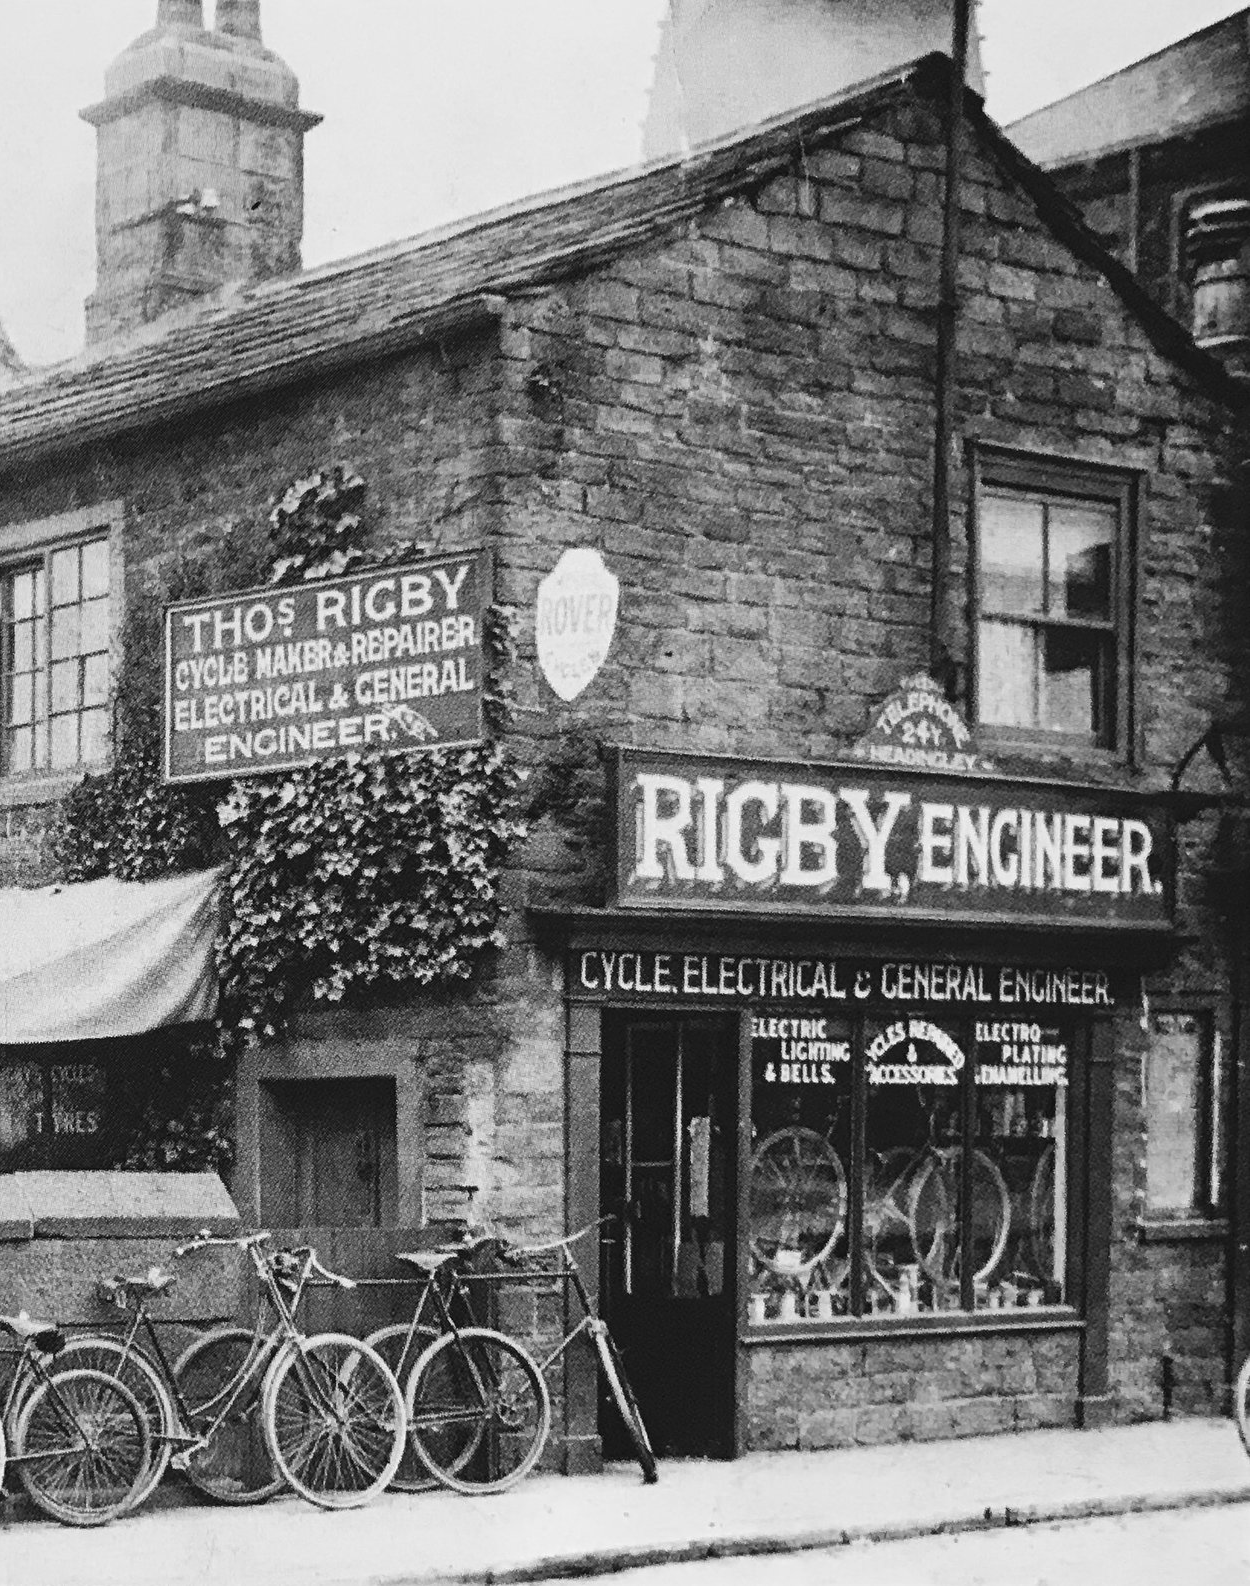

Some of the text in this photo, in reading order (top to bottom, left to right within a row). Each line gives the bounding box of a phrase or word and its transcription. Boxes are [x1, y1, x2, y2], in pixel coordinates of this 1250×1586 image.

[315, 565, 470, 630] RIGBY
[539, 592, 613, 636] ROVER
[175, 652, 249, 691] CYCLE
[255, 637, 332, 680] MAKER
[333, 641, 350, 668] &
[174, 657, 475, 732] ELECTRICAL & GENERAL
[876, 692, 971, 749] TELEPHONE
[870, 745, 977, 771] HEADINGLEY
[635, 773, 1164, 903] RIGBY, ENGINEER.
[683, 955, 846, 999] ELECTRICAL
[881, 962, 992, 1001] GENERAL
[750, 1016, 827, 1039] ELECTRIC
[764, 1061, 777, 1083] &
[781, 1039, 851, 1062] LIGHTING
[1001, 1043, 1067, 1066] PLATING
